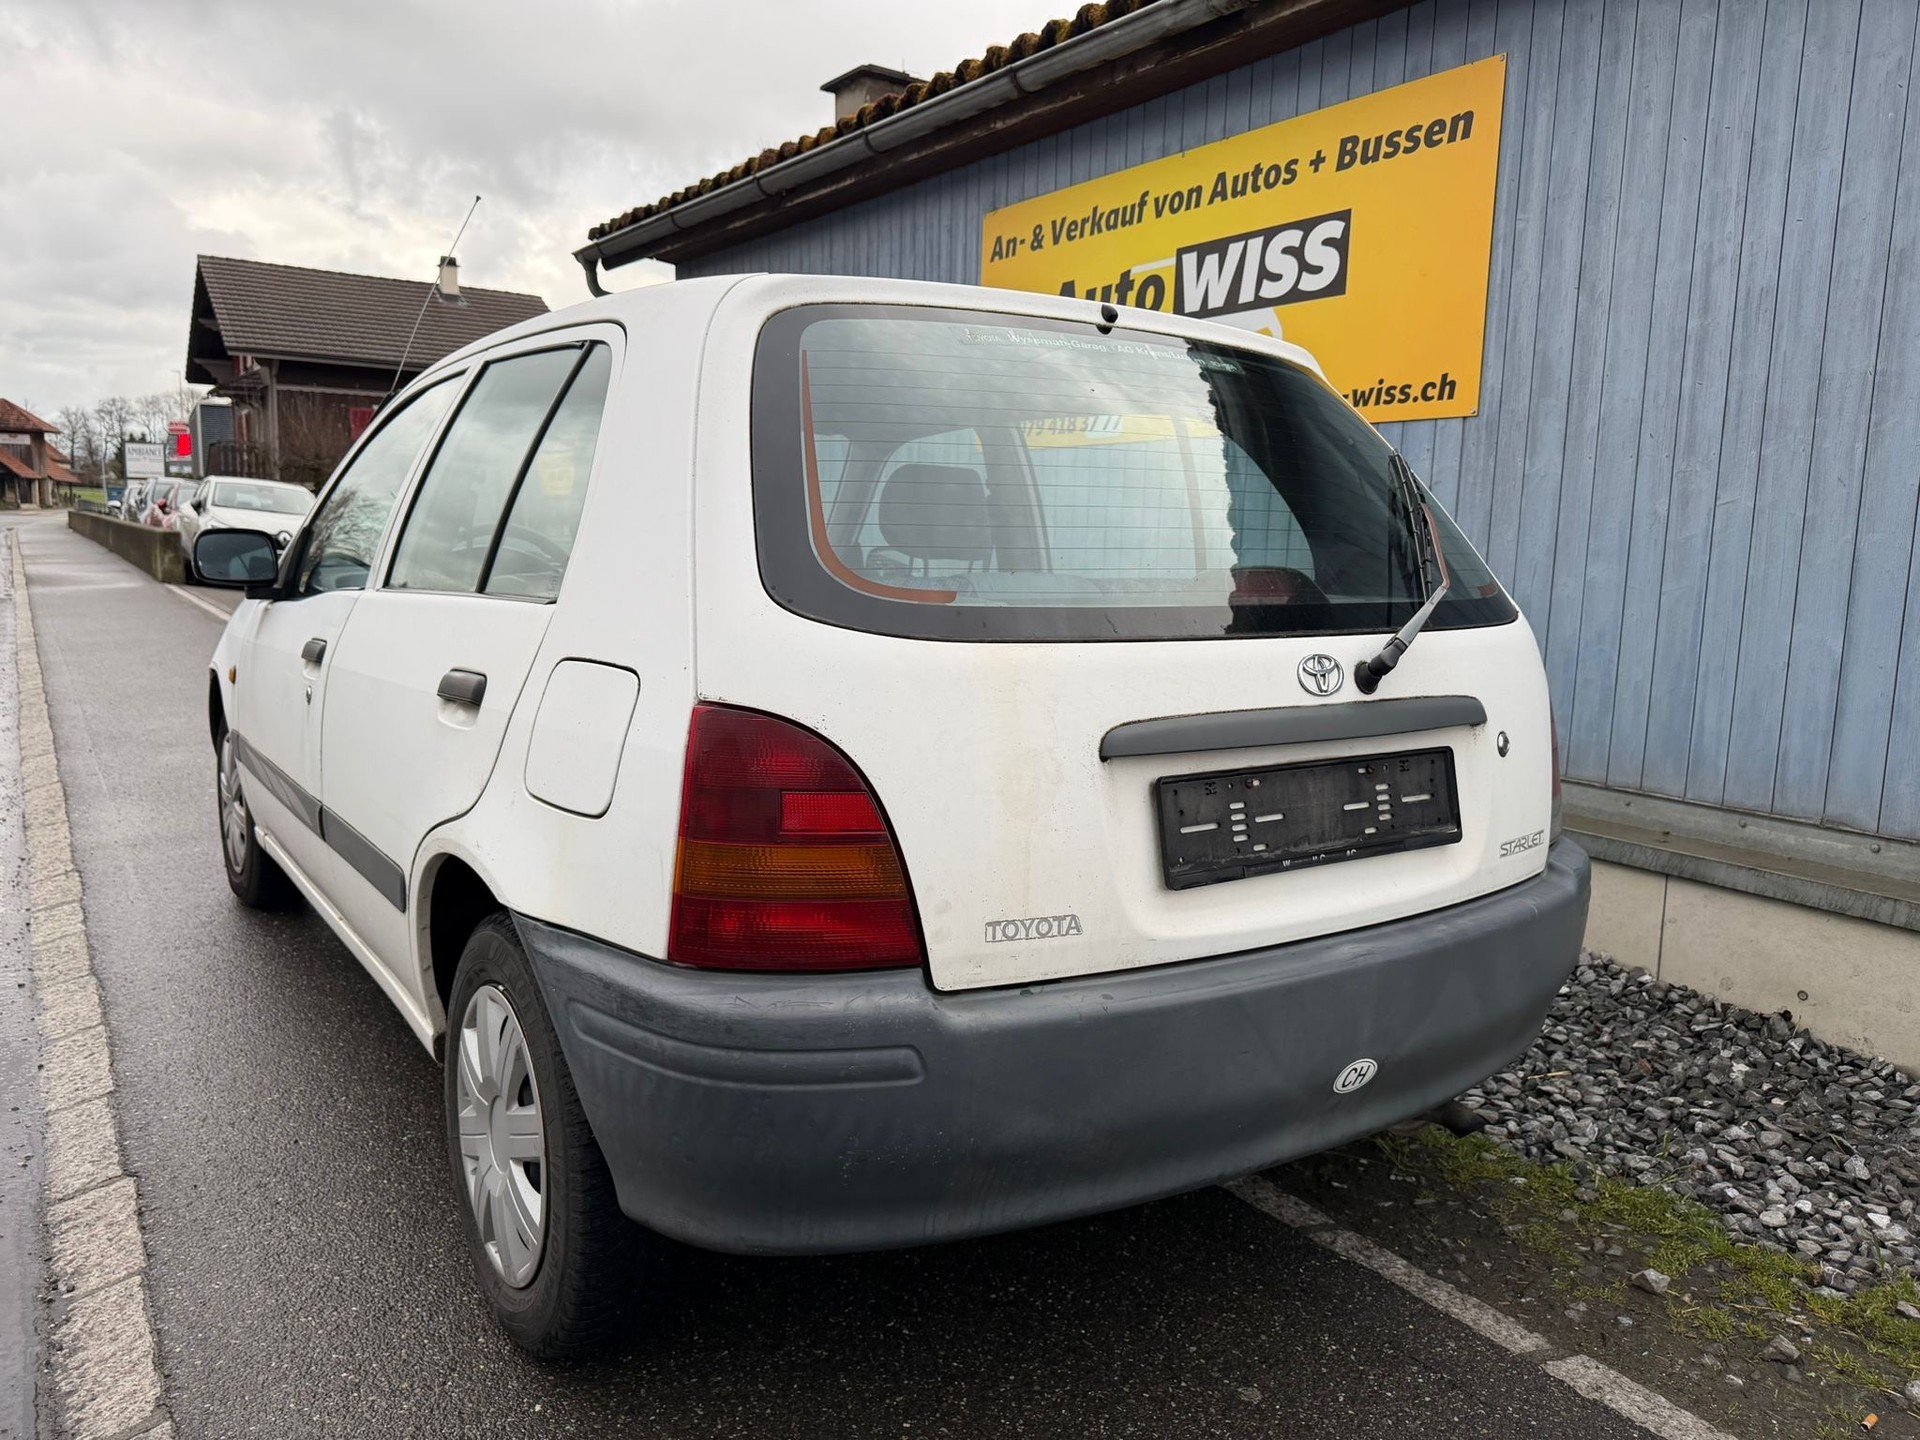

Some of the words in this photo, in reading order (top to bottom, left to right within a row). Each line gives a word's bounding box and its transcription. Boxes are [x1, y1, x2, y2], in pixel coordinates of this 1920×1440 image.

[989, 235, 1026, 263] An-
[1030, 224, 1045, 252] &
[1051, 190, 1150, 246] Verkauf
[1153, 184, 1203, 219] von
[1207, 157, 1300, 206] Autos
[1309, 149, 1327, 174] +
[1335, 110, 1475, 173] Bussen
[1181, 219, 1346, 314] WISS
[1499, 829, 1544, 858] STARLET
[985, 914, 1083, 942] TOYOTA
[1342, 1064, 1371, 1088] CH
